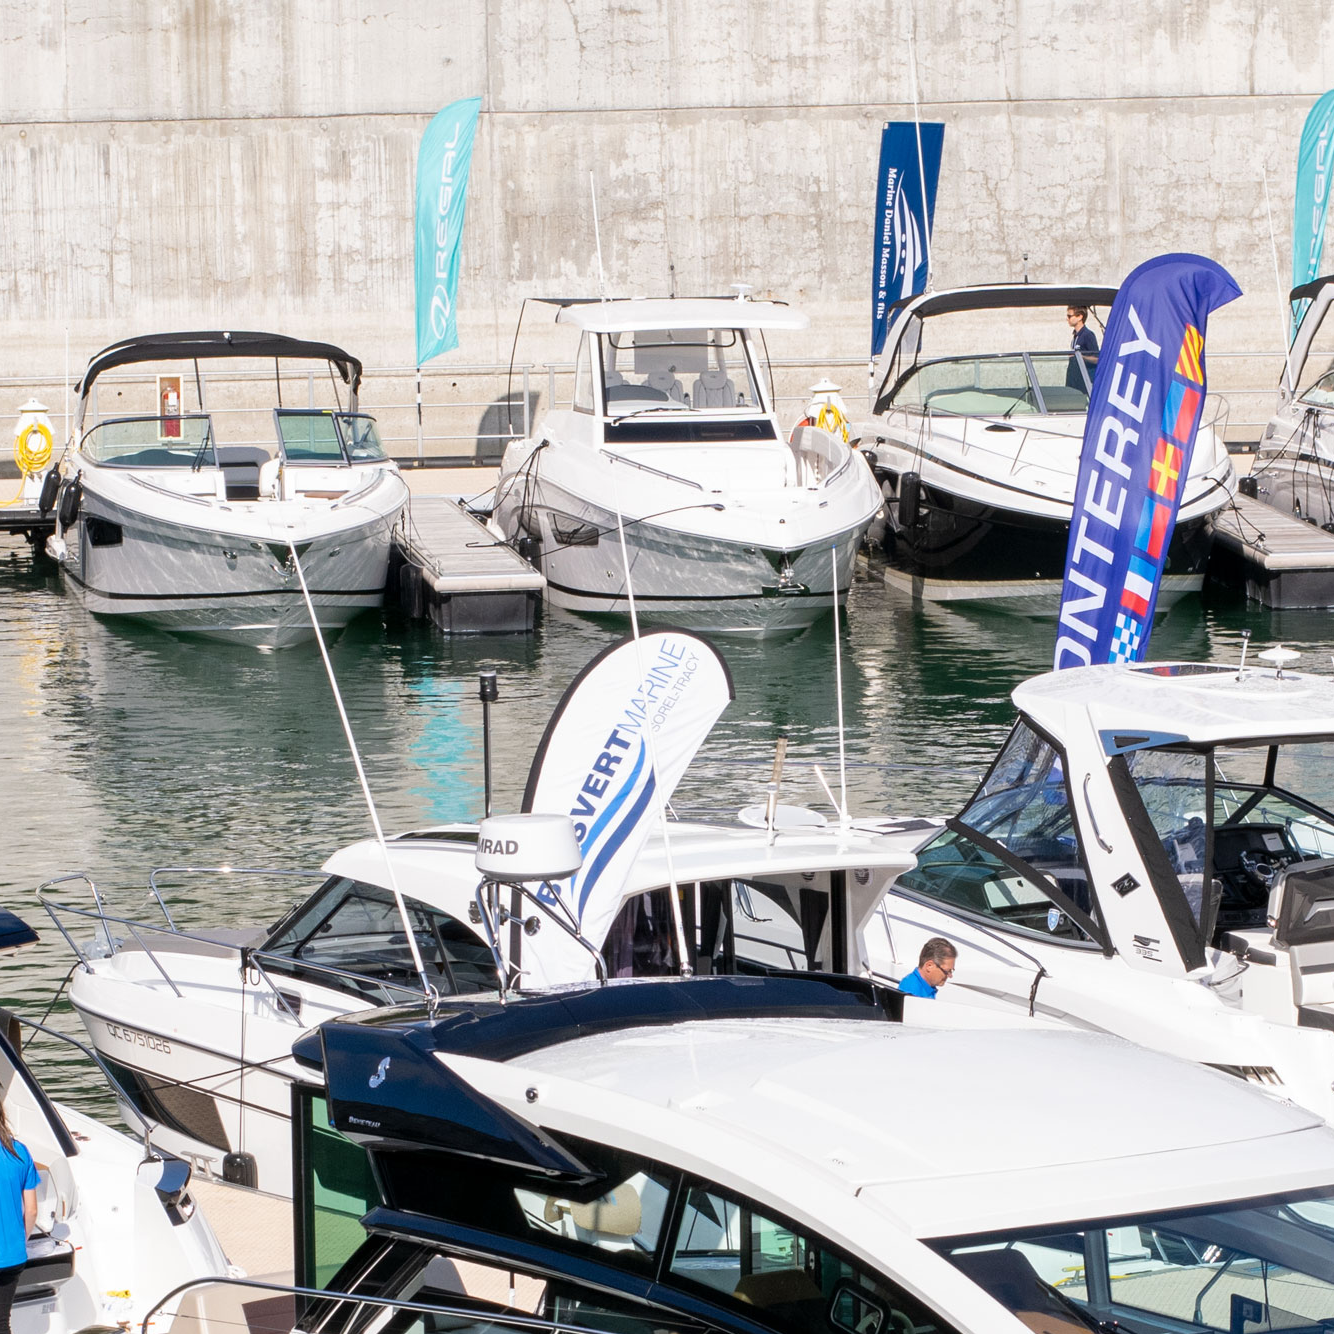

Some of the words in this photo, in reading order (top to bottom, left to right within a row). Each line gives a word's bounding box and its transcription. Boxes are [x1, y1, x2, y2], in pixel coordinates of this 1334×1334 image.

[435, 122, 460, 279] REGAL
[885, 167, 898, 207] Marine
[882, 209, 894, 245] Daniel
[878, 247, 891, 288] Masson
[877, 290, 887, 299] &
[1053, 303, 1162, 671] ONTEREY
[651, 651, 701, 734] SOREL-TRACY
[106, 1022, 123, 1040] QC
[123, 1028, 172, 1055] 6751026
